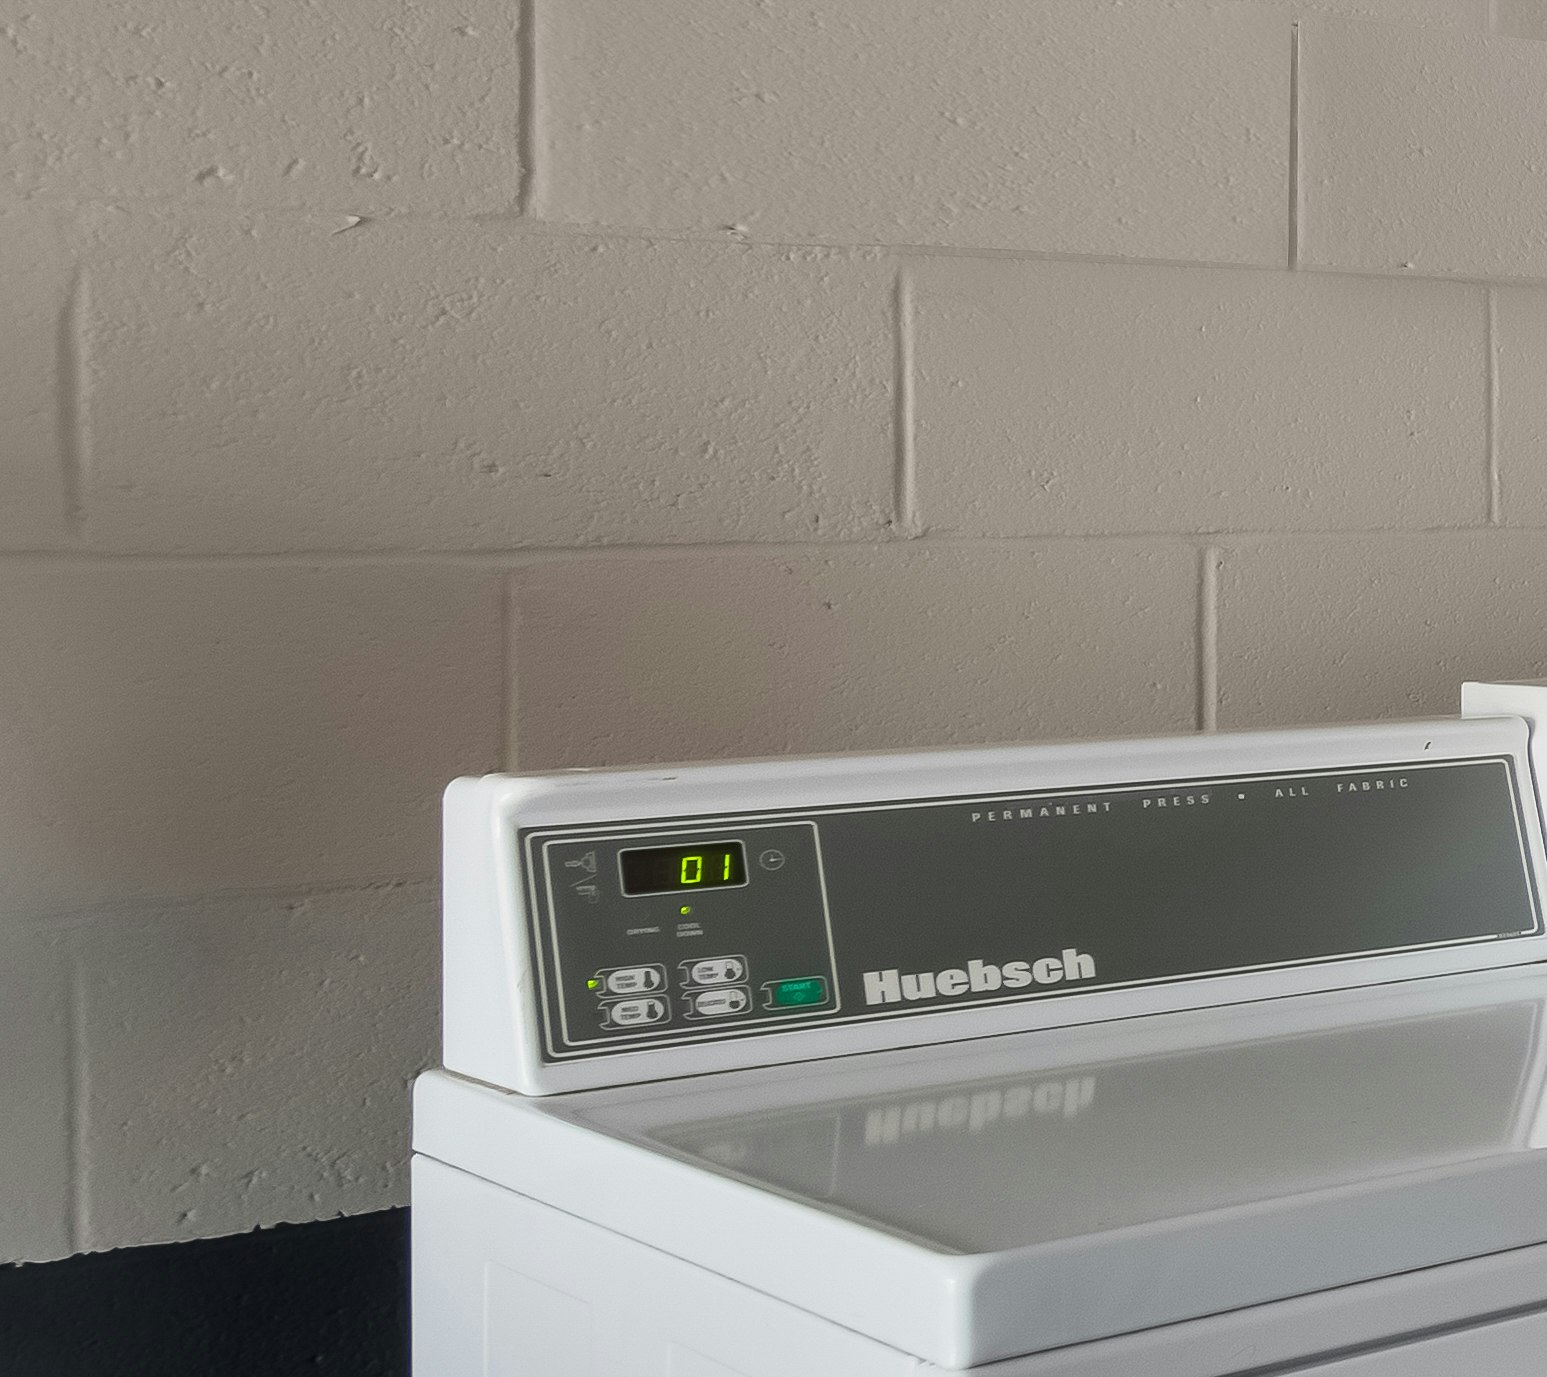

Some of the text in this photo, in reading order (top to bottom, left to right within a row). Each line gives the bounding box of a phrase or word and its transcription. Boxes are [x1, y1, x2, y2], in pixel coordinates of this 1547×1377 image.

[971, 777, 1409, 823] PERMANENT PRESS ALL FABRIC
[680, 853, 731, 884] 01
[863, 948, 1097, 1006] Huebsch
